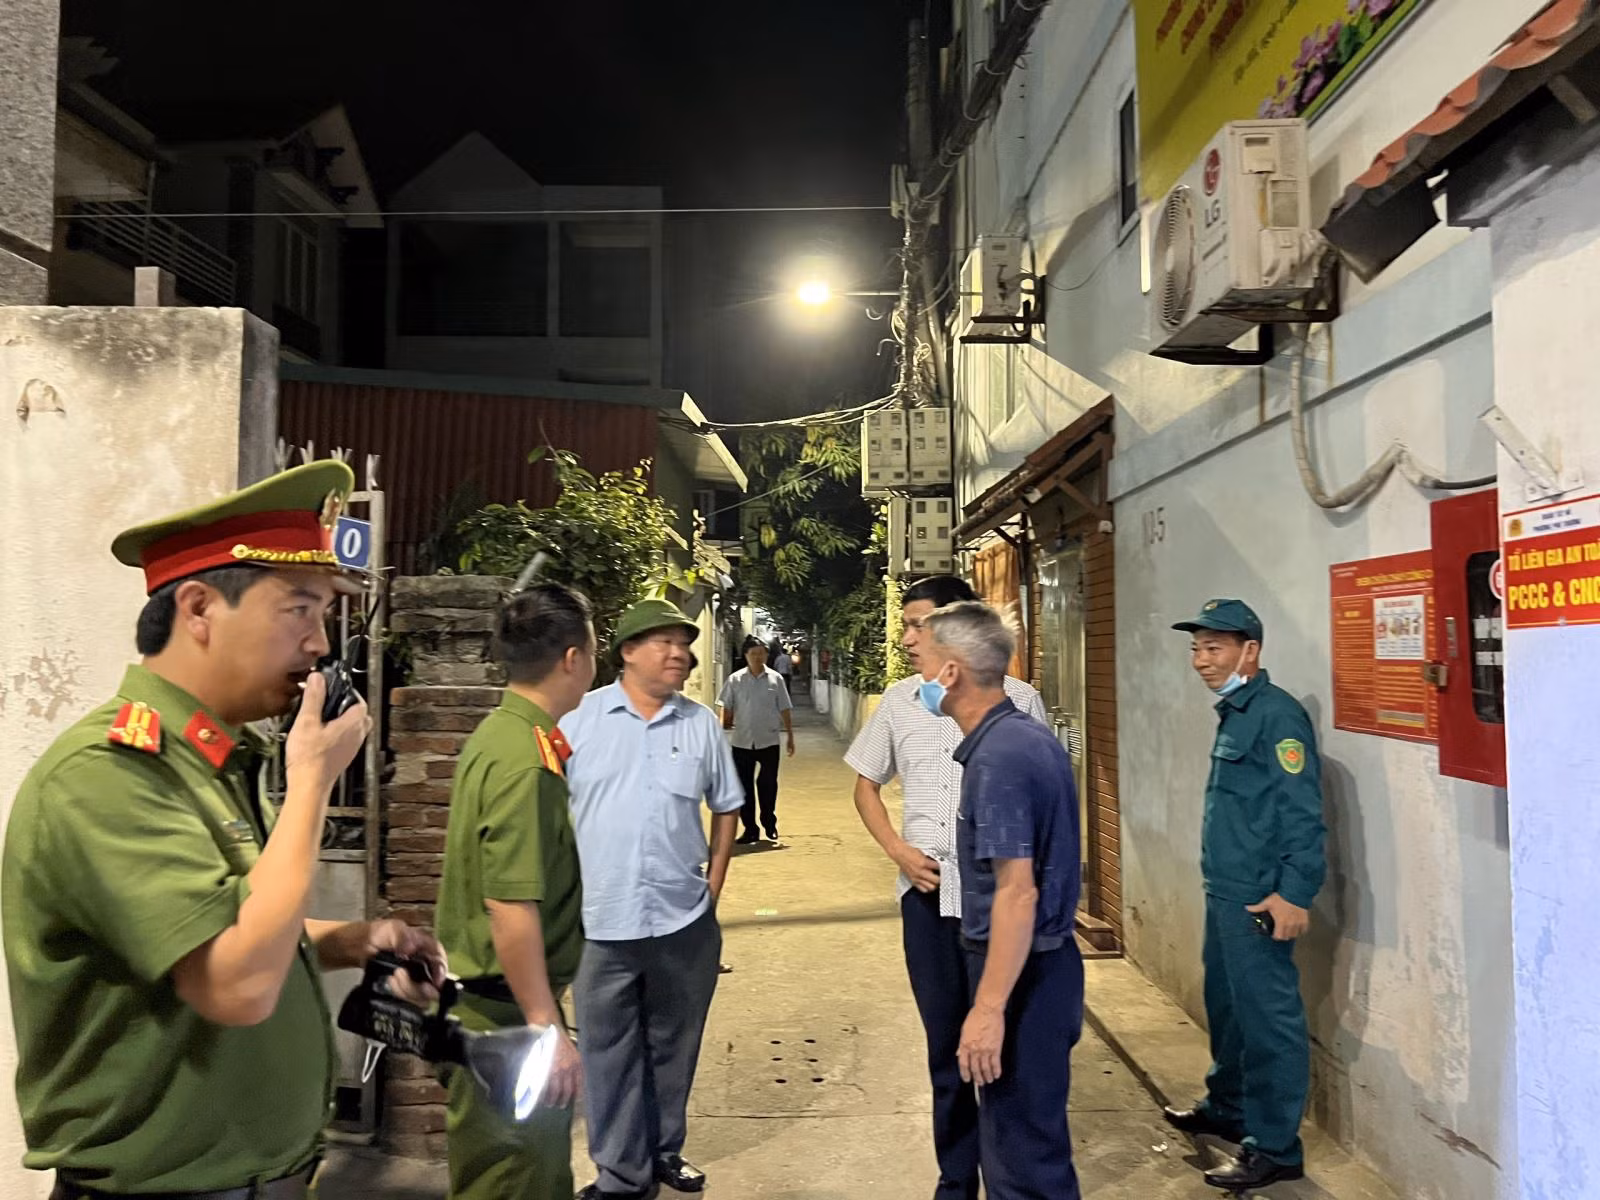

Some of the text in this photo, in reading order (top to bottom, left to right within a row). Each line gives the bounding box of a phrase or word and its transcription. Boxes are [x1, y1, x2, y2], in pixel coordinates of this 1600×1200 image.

[1205, 199, 1220, 228] LG
[1508, 582, 1550, 611] PCCC
[1553, 581, 1566, 607] &
